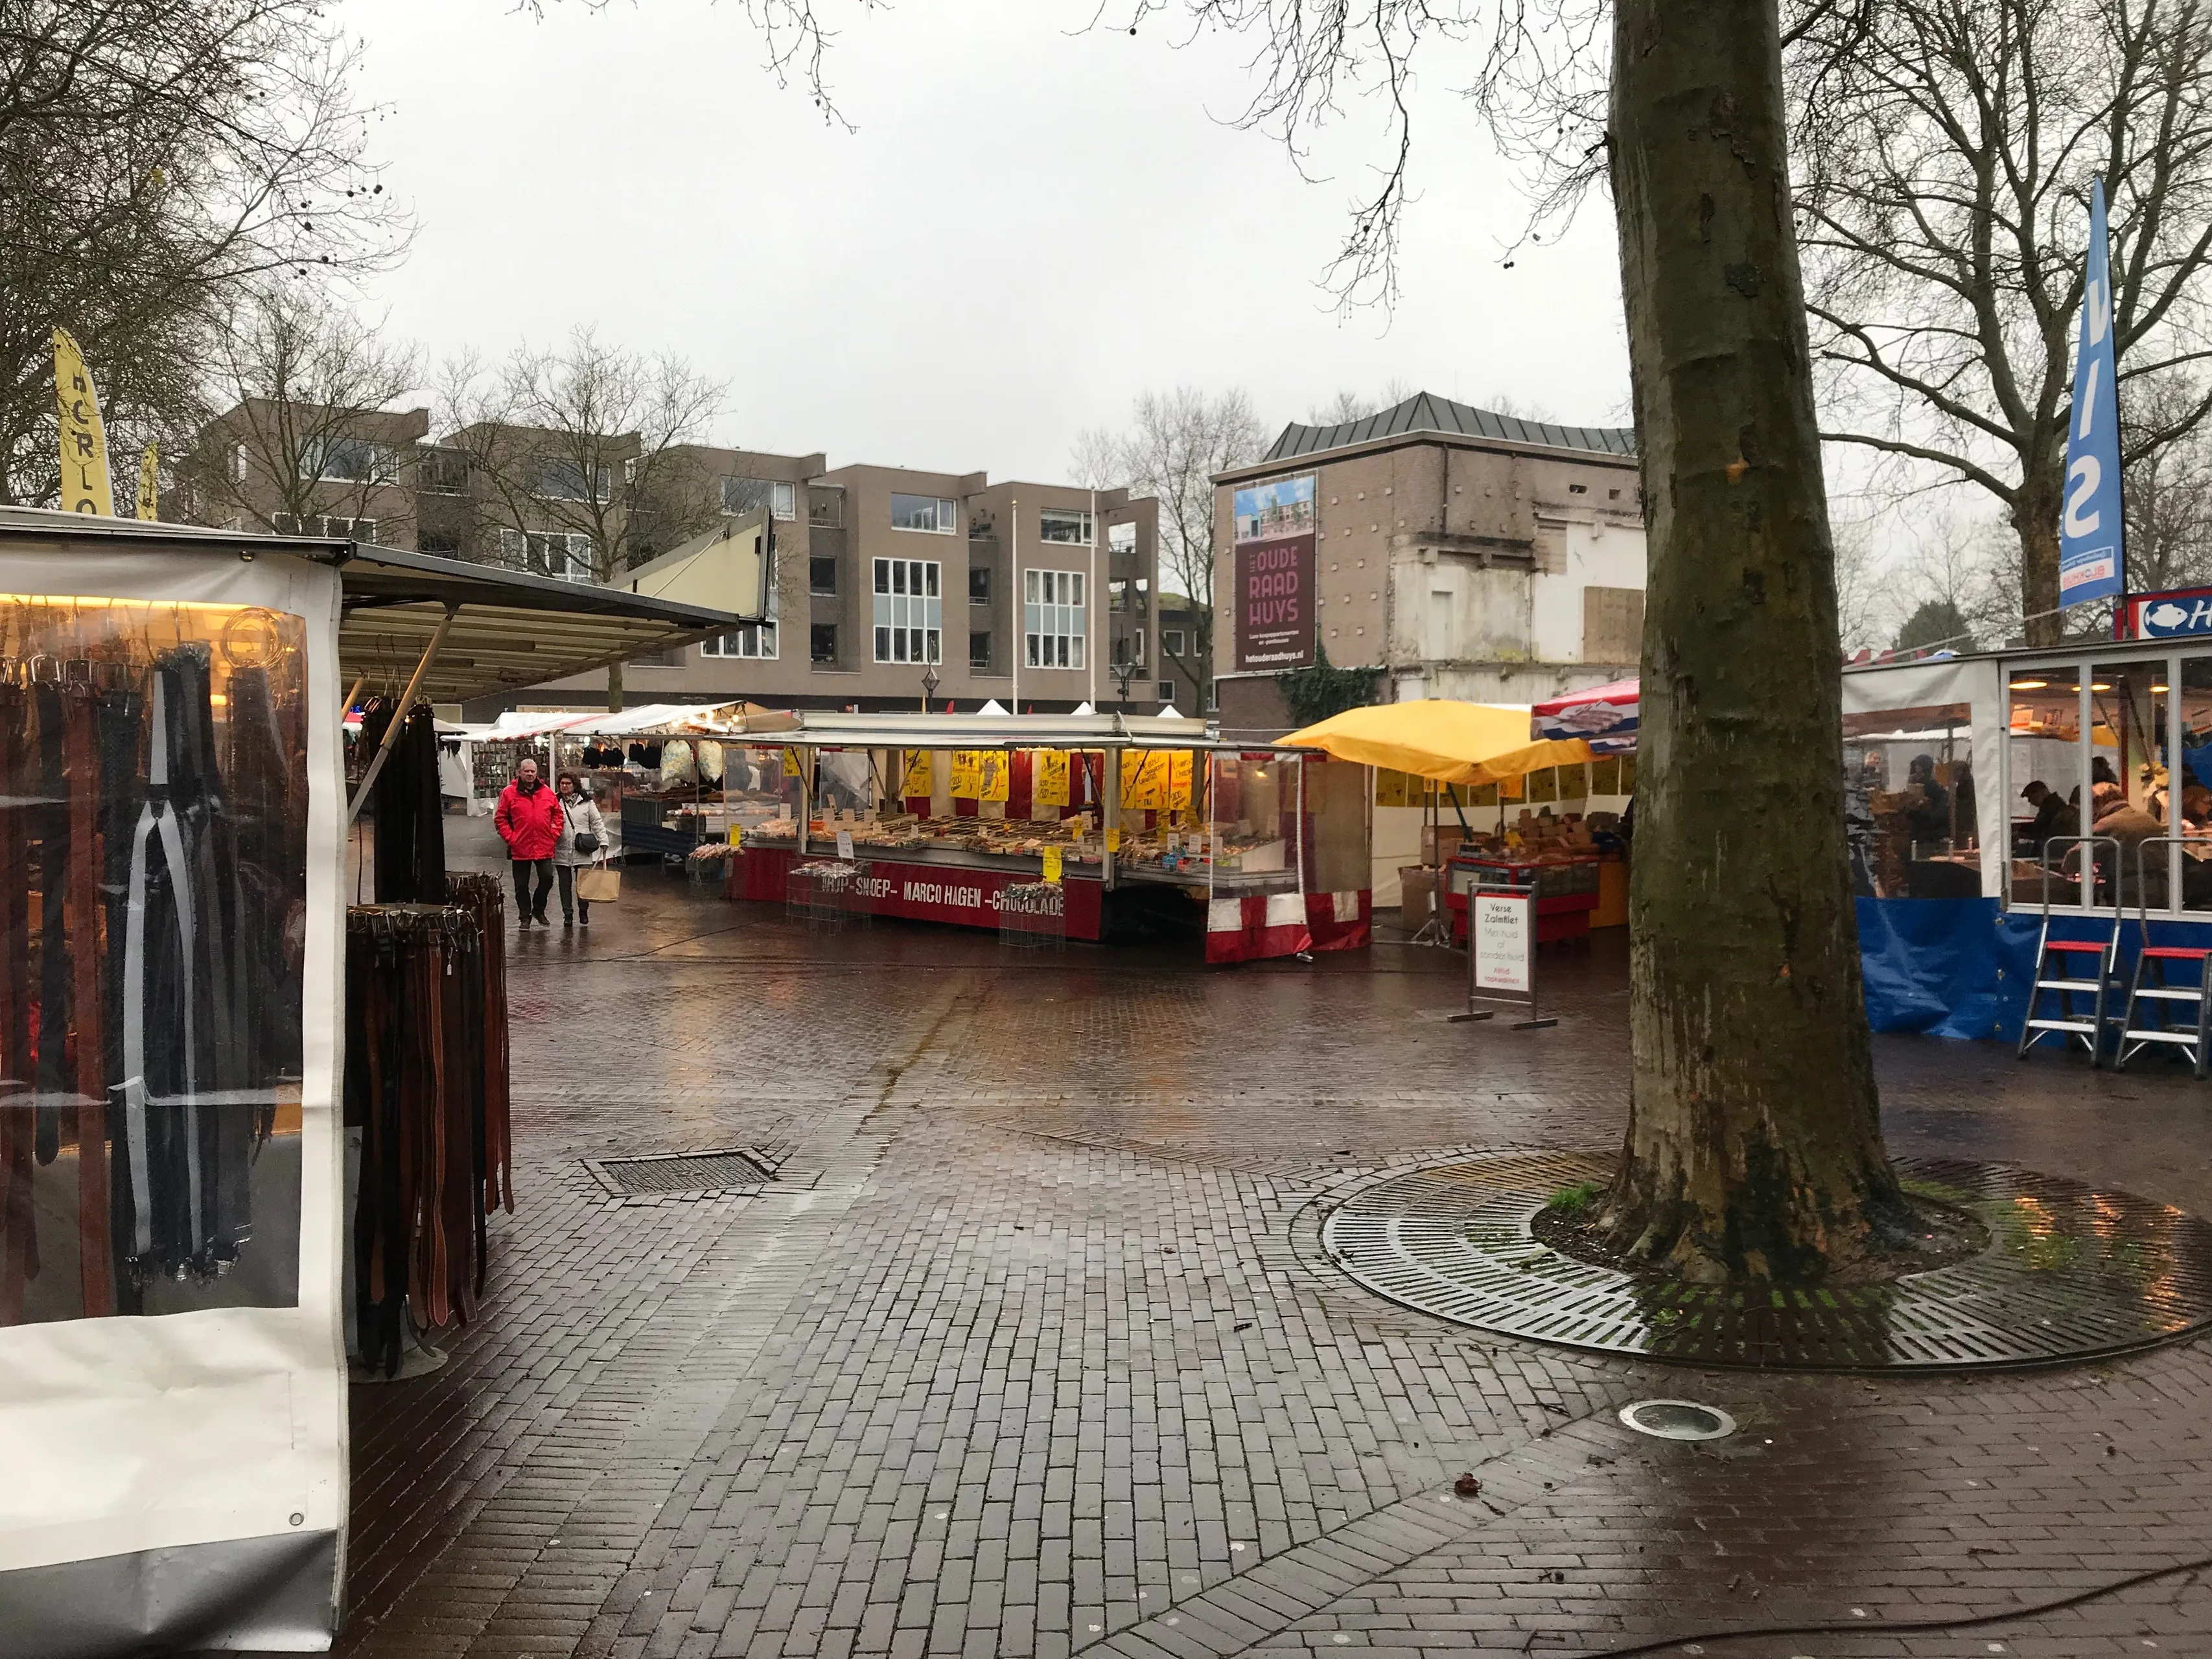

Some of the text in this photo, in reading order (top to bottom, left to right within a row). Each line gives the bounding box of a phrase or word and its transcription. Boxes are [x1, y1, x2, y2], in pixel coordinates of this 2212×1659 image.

[1257, 546, 1298, 571] OUDE
[1249, 571, 1299, 599] RAAD
[1249, 598, 1299, 625] HUYS
[1245, 649, 1305, 663] hetouderaadhuys.nl
[903, 881, 942, 905] MARCO
[944, 885, 981, 909] HAGEN
[1490, 903, 1512, 912] Verse
[1484, 914, 1519, 924] Zalmfilet
[1497, 940, 1505, 949] of
